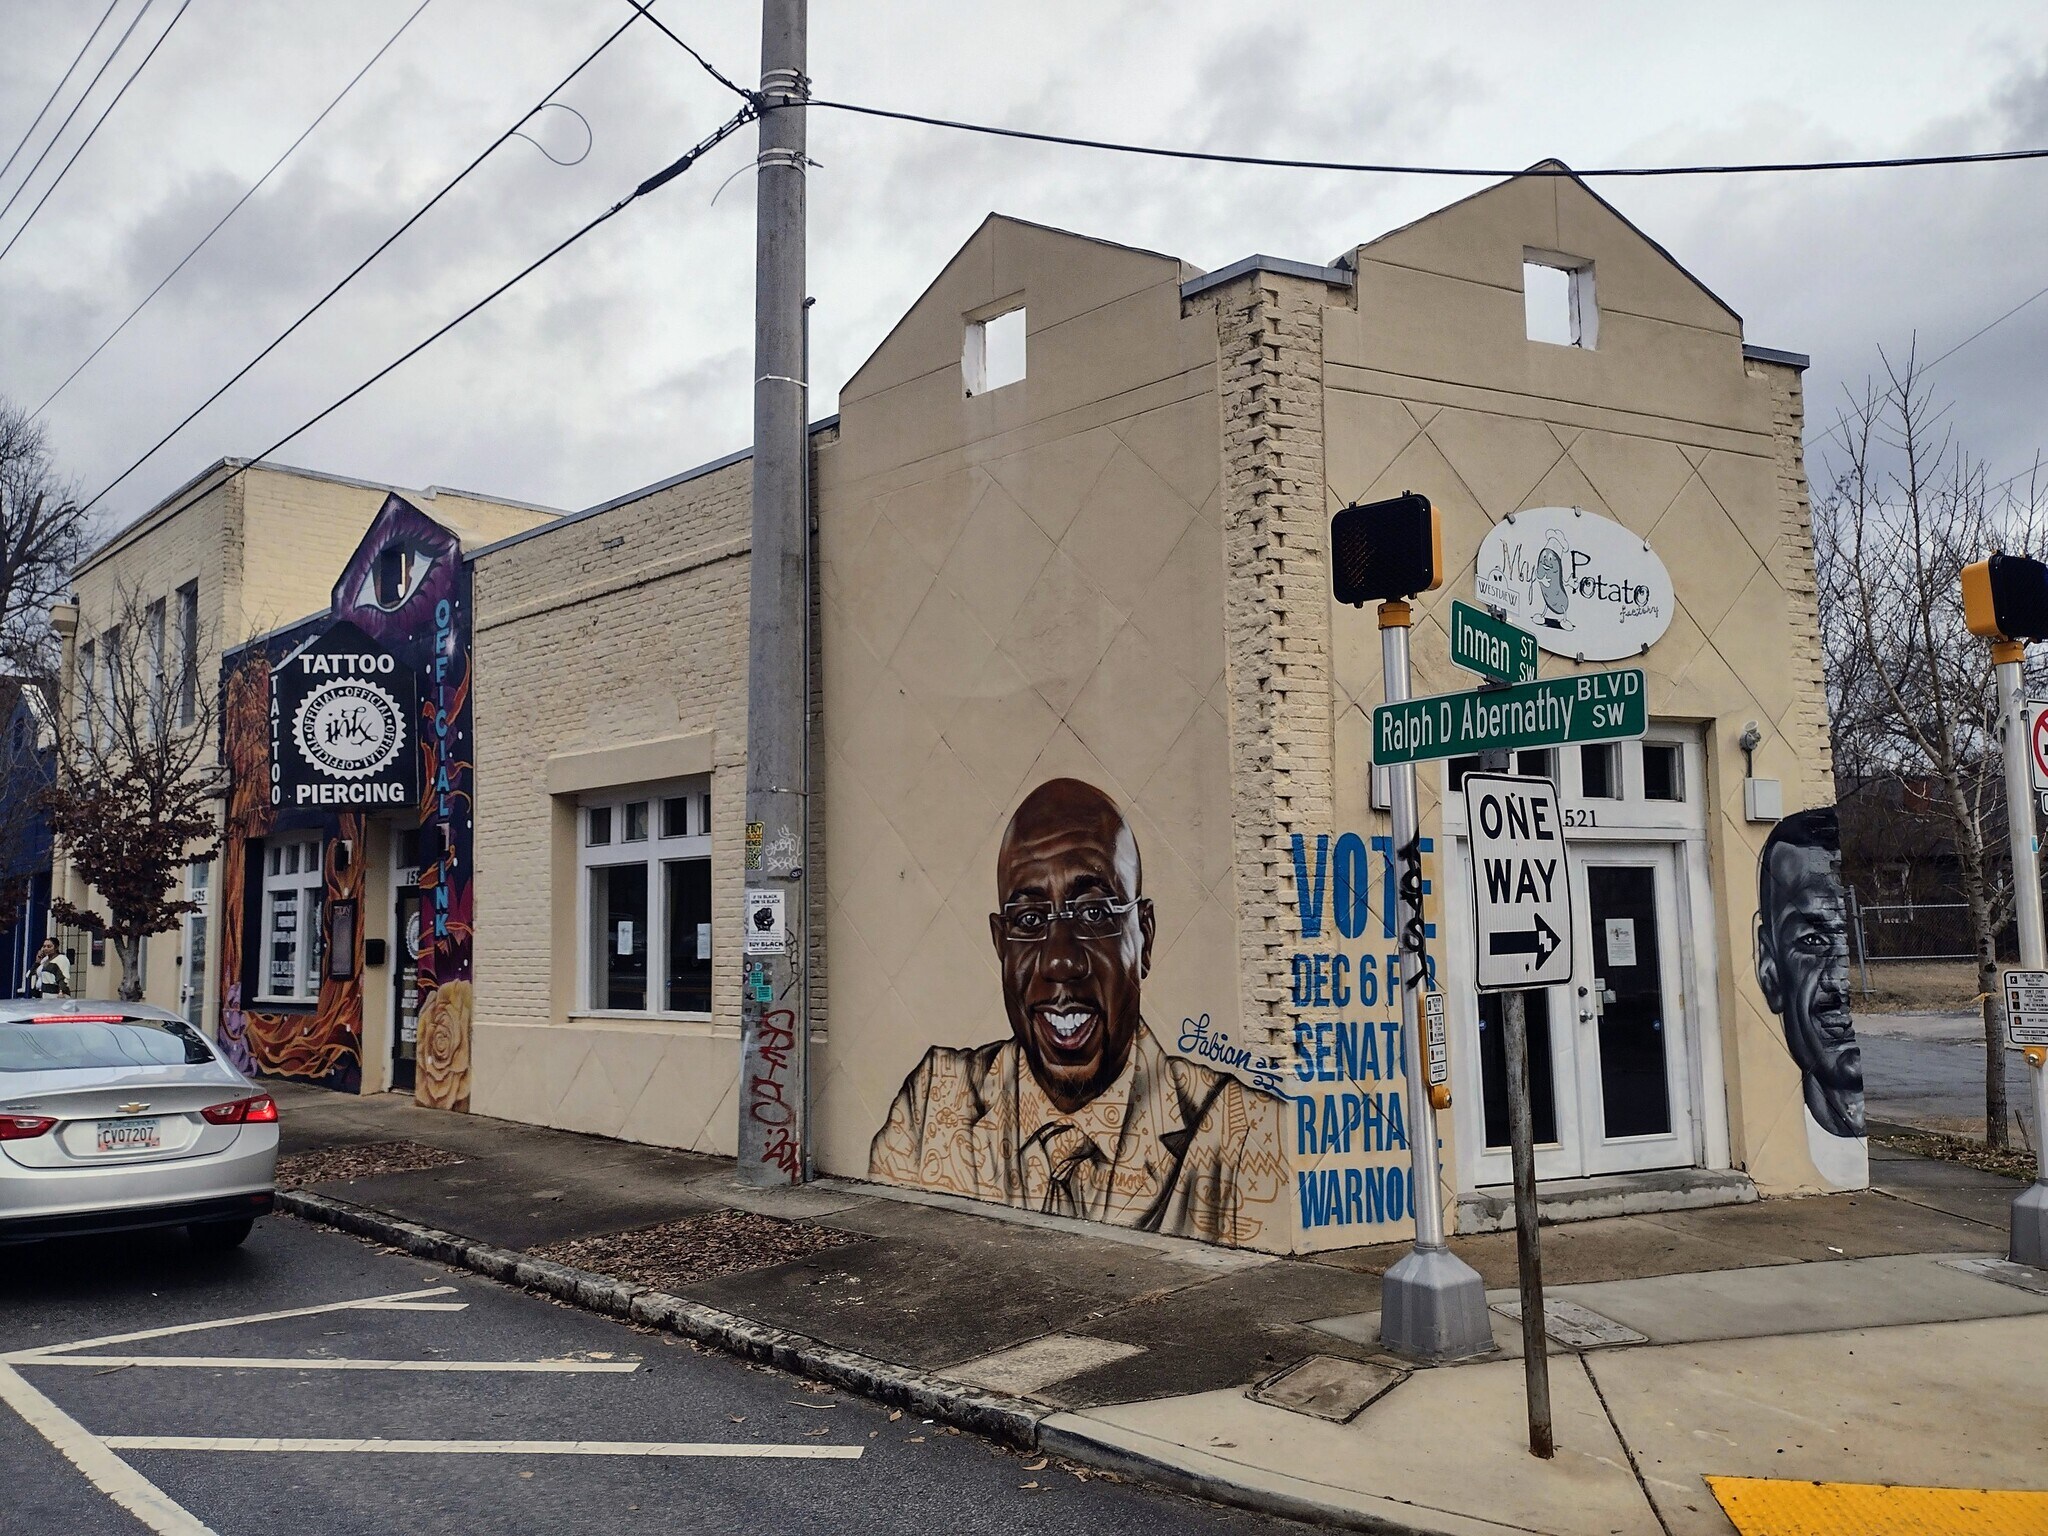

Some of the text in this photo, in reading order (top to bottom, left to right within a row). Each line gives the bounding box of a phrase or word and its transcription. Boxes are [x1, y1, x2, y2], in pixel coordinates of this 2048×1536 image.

[1478, 580, 1519, 607] WESTVIEW
[1500, 538, 1537, 606] My
[1570, 550, 1650, 607] Potato
[298, 653, 396, 675] TATTOO
[1457, 610, 1510, 674] Inman
[1520, 635, 1534, 660] ST
[1519, 660, 1535, 683] SW
[1577, 671, 1640, 702] BLVD
[345, 687, 392, 721] OFFICIAL
[1381, 686, 1575, 758] Ralph D Abernathy
[1592, 701, 1626, 729] SW
[270, 675, 281, 805] TATTOO
[434, 598, 450, 937] OFFICIAL INK
[296, 782, 405, 805] PIERCING
[1479, 793, 1555, 840] ONE
[1483, 858, 1558, 905] WAY
[1292, 953, 1351, 1008] DEC
[1359, 953, 1379, 1008] 6
[1293, 1021, 1408, 1083] SENAT
[1297, 1091, 1443, 1155] RAPHA
[1297, 1165, 1443, 1229] WARNO
